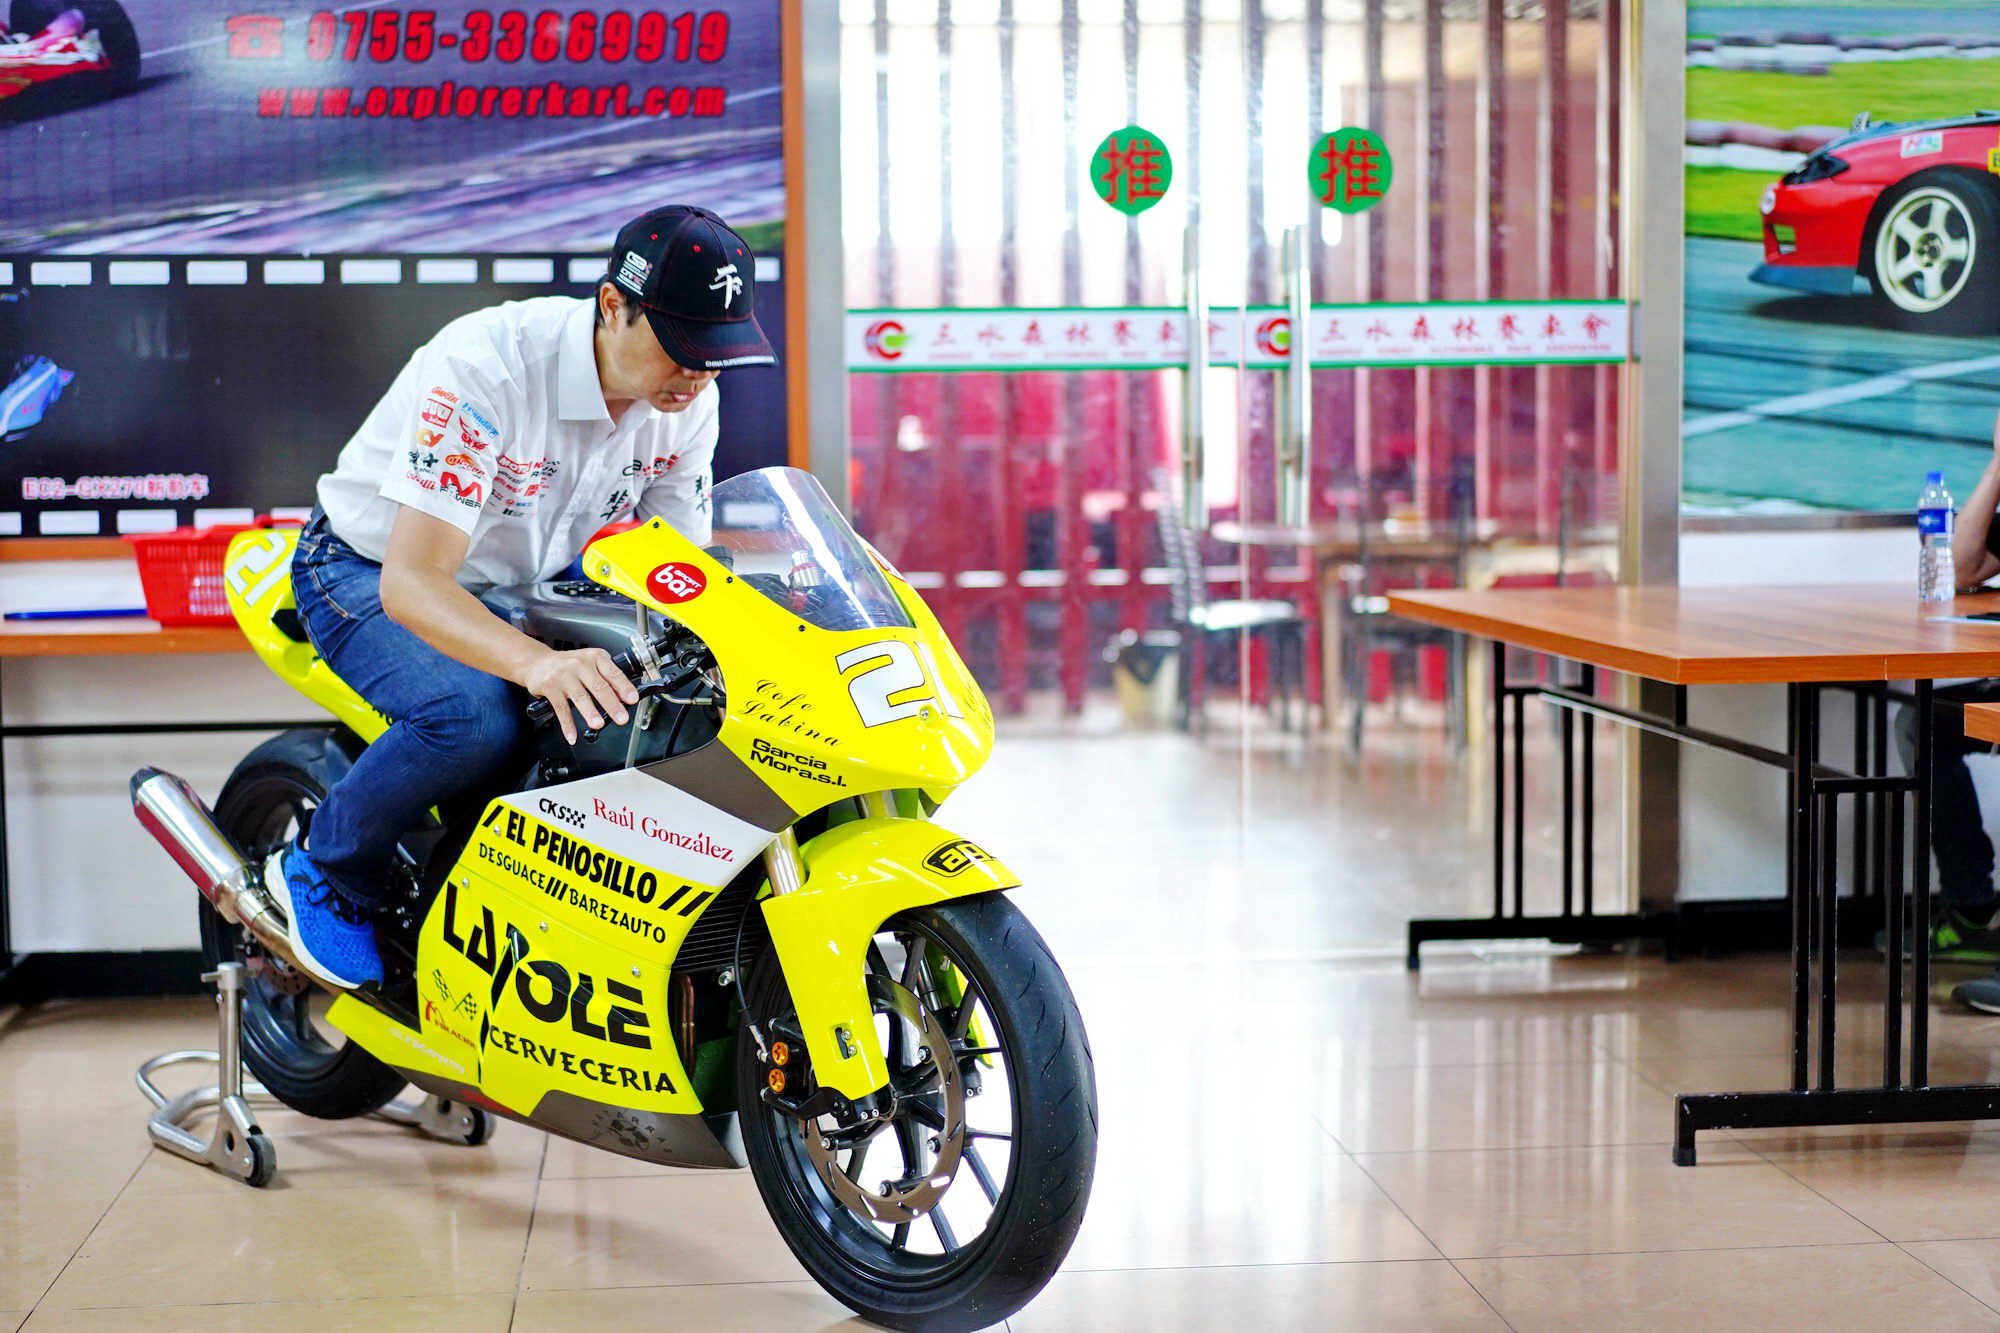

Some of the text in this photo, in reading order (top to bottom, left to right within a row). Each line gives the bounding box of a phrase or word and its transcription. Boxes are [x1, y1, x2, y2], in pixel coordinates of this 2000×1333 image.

[306, 11, 729, 62] 0755-33869919
[258, 82, 727, 120] www.explorerkart.com
[1101, 138, 1165, 204] 推
[1319, 137, 1383, 203] 推
[655, 565, 696, 597] bar
[752, 738, 828, 770] Garcia
[539, 798, 566, 820] CKS
[592, 797, 734, 862] Raúl González
[506, 810, 657, 904] EL PENOSILLO
[489, 1025, 678, 1094] CERVECERIA
